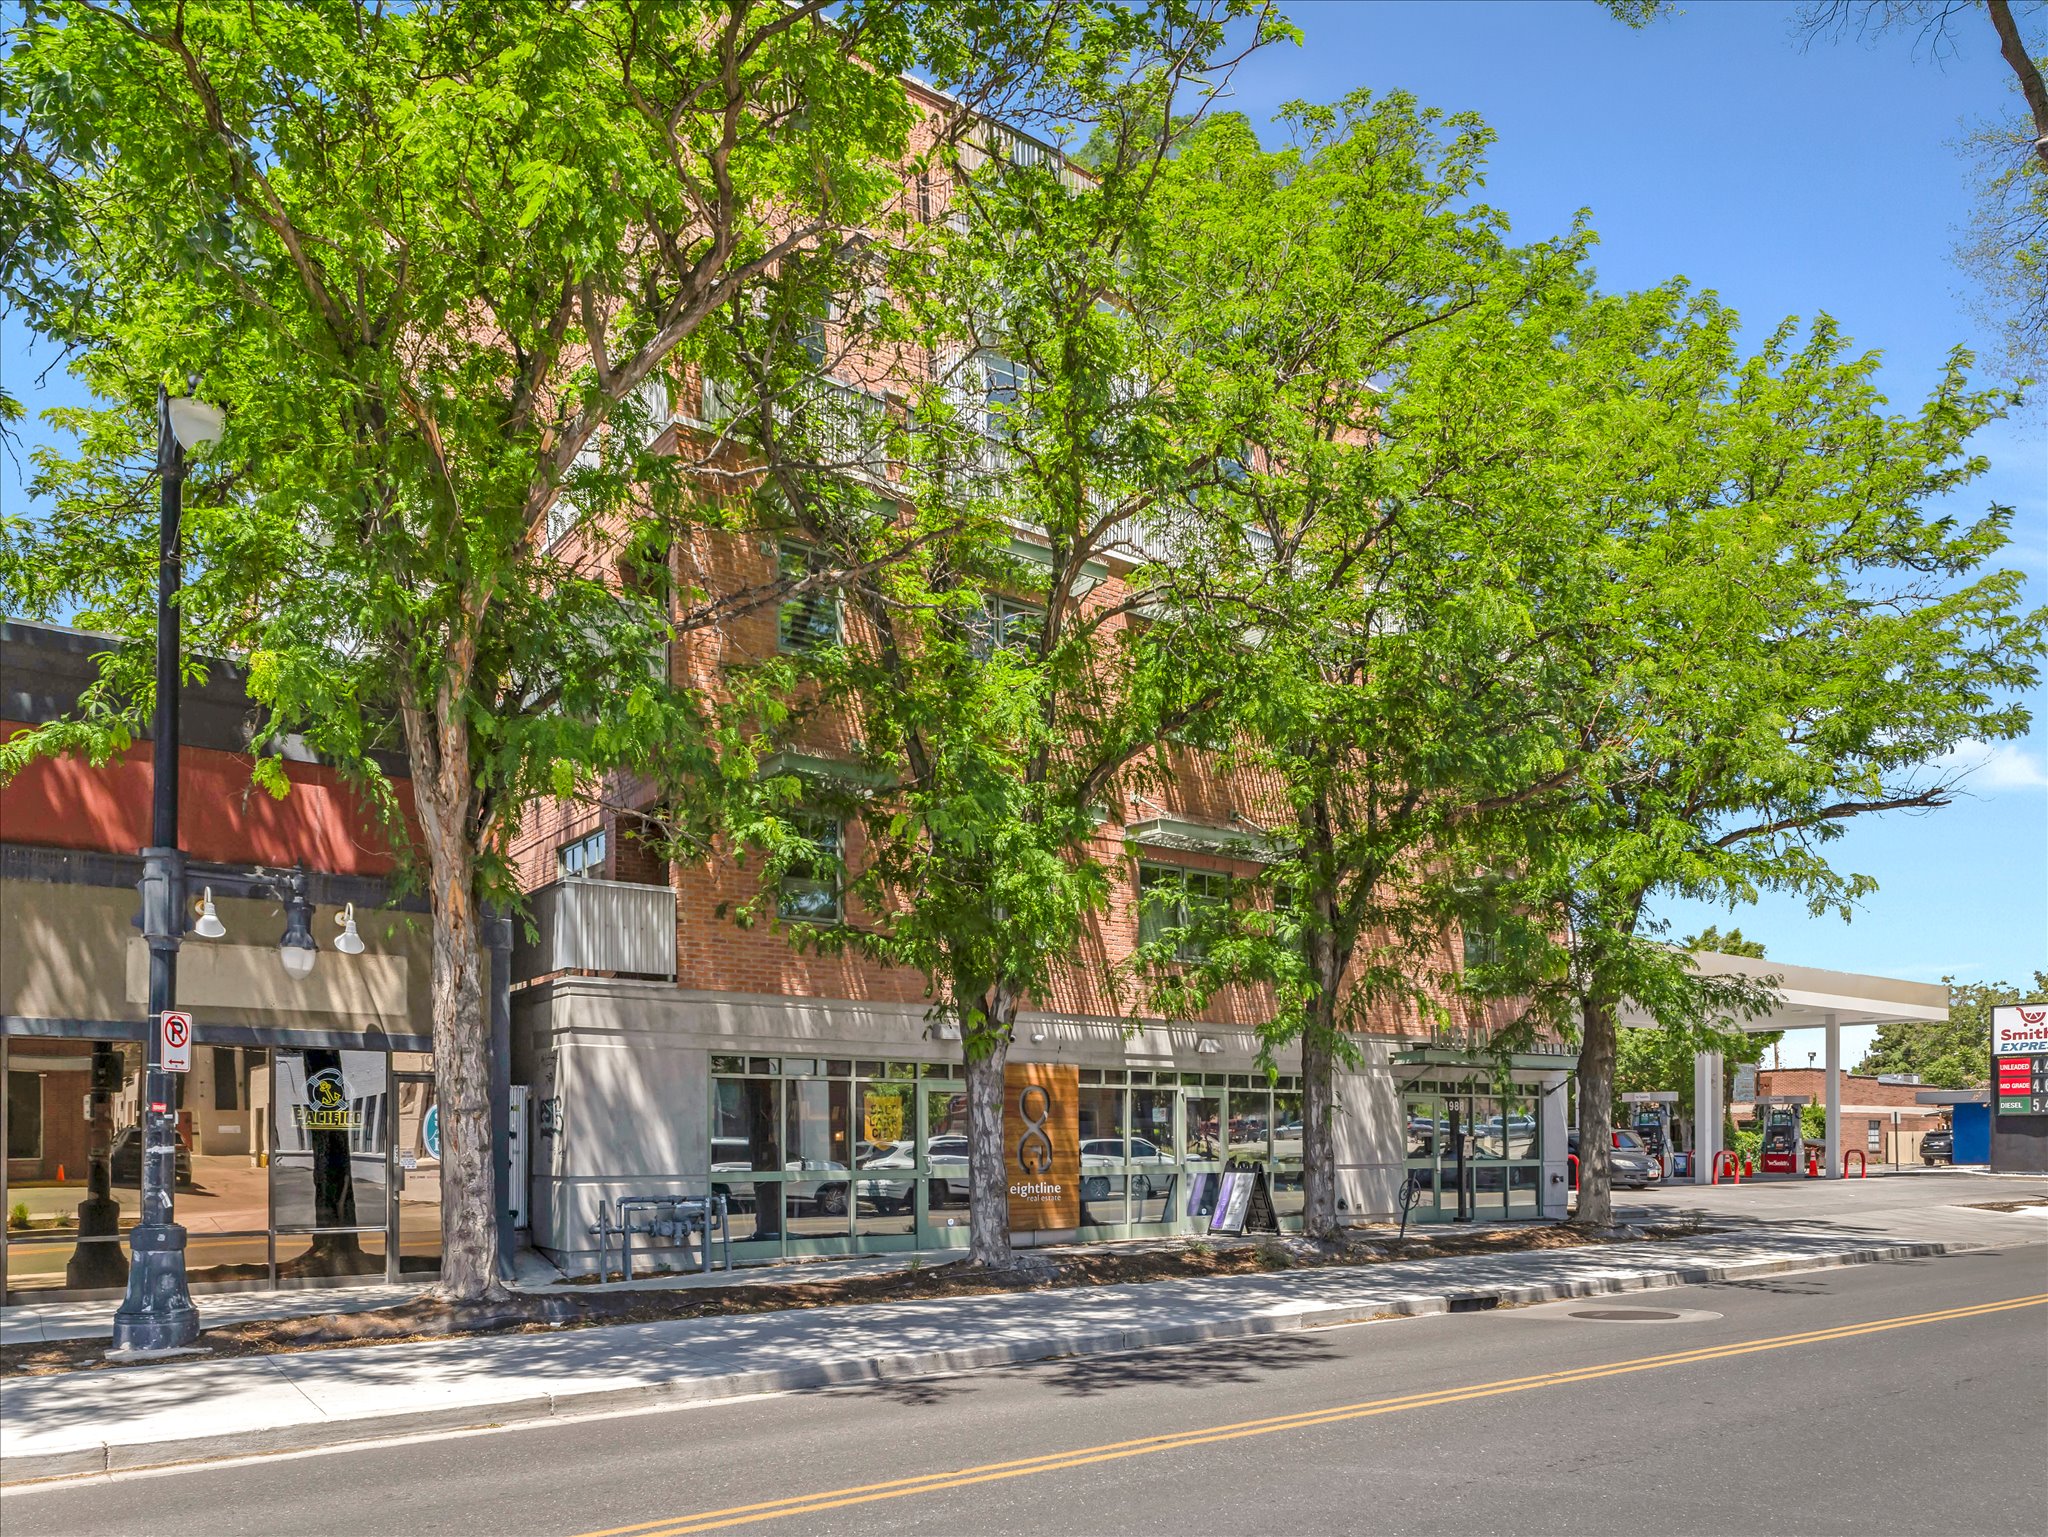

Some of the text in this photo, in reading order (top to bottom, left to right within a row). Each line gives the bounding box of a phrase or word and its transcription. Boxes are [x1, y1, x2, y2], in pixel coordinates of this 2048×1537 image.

[2001, 1041, 2048, 1052] EXPRE
[1444, 1101, 1464, 1111] 1988
[1009, 1182, 1061, 1197] eightline
[1027, 1194, 1061, 1202] real estate
